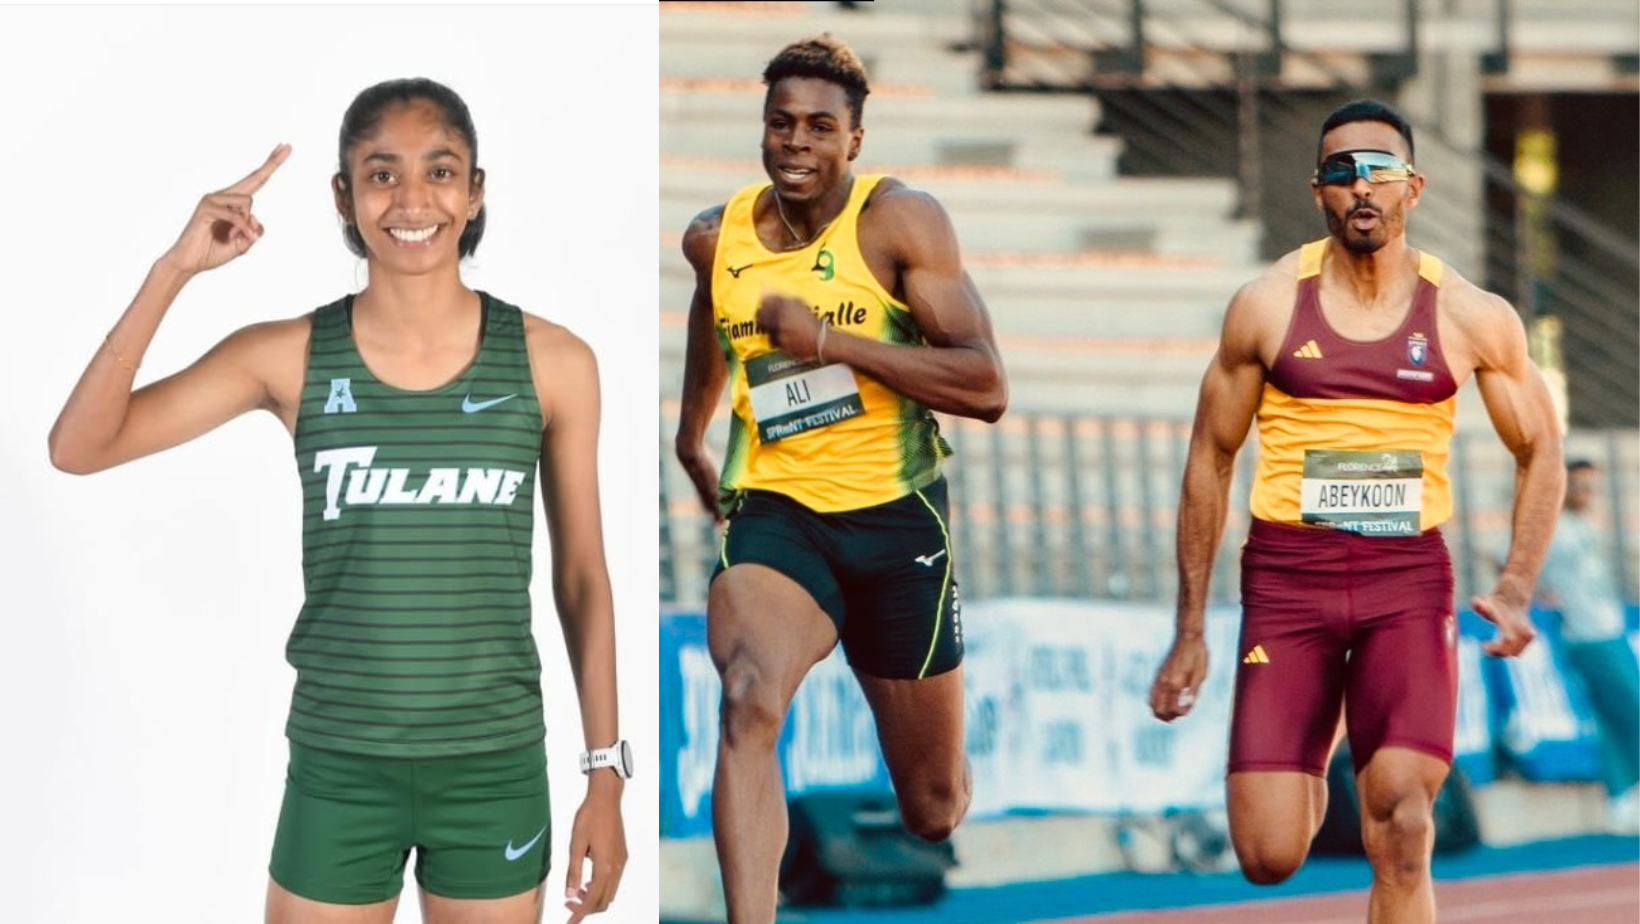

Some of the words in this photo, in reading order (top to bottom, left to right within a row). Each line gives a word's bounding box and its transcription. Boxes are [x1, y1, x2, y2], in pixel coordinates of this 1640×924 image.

[810, 301, 867, 326] ialle
[324, 378, 357, 413] A
[785, 379, 811, 407] ALI
[804, 403, 856, 427] FESTIVAL
[314, 446, 526, 521] TULANE
[1318, 484, 1406, 508] ABEYKOON
[1361, 521, 1414, 532] FESTIVAL
